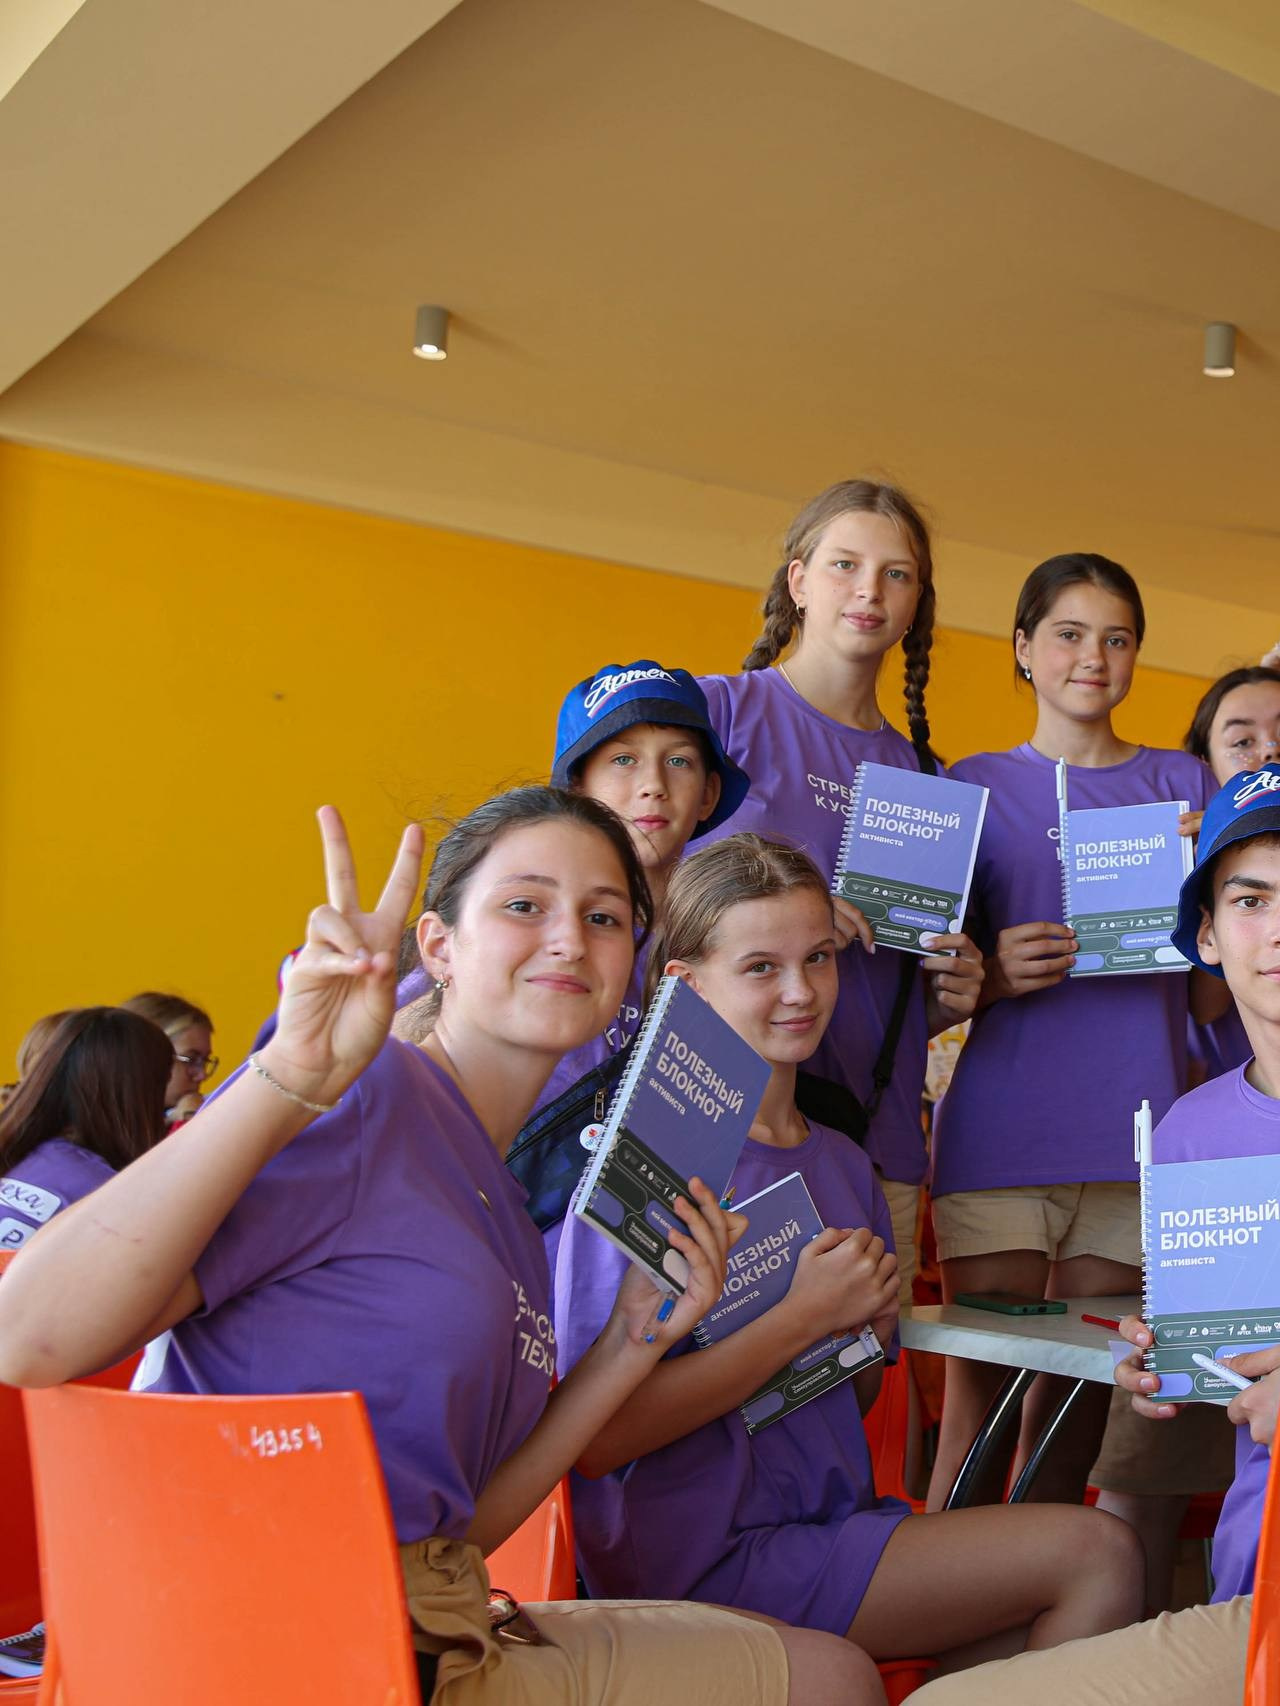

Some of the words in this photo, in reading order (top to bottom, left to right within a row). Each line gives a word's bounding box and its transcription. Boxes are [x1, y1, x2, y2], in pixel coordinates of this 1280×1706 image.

[862, 813, 944, 842] БЛОКНОТ
[865, 797, 961, 830] ПОЛЕЗНЫЙ
[859, 831, 904, 848] активиста
[1075, 833, 1166, 856] ПОЛЕЗНЫЙ
[1076, 852, 1153, 871] БЛОКНОТ
[1076, 873, 1118, 883] активиста
[664, 1030, 744, 1115] ПОЛЕЗНЫЙ
[649, 1078, 686, 1116] активиста
[656, 1052, 725, 1123] БЛОКНОТ
[1160, 1199, 1280, 1229] ПОЛЕЗНЫЙ
[726, 1219, 802, 1276] ЛЕЗНЫЙ
[1161, 1226, 1262, 1251] БЛОКНОТ
[1160, 1255, 1216, 1268] активиста
[710, 1290, 761, 1322] активиста
